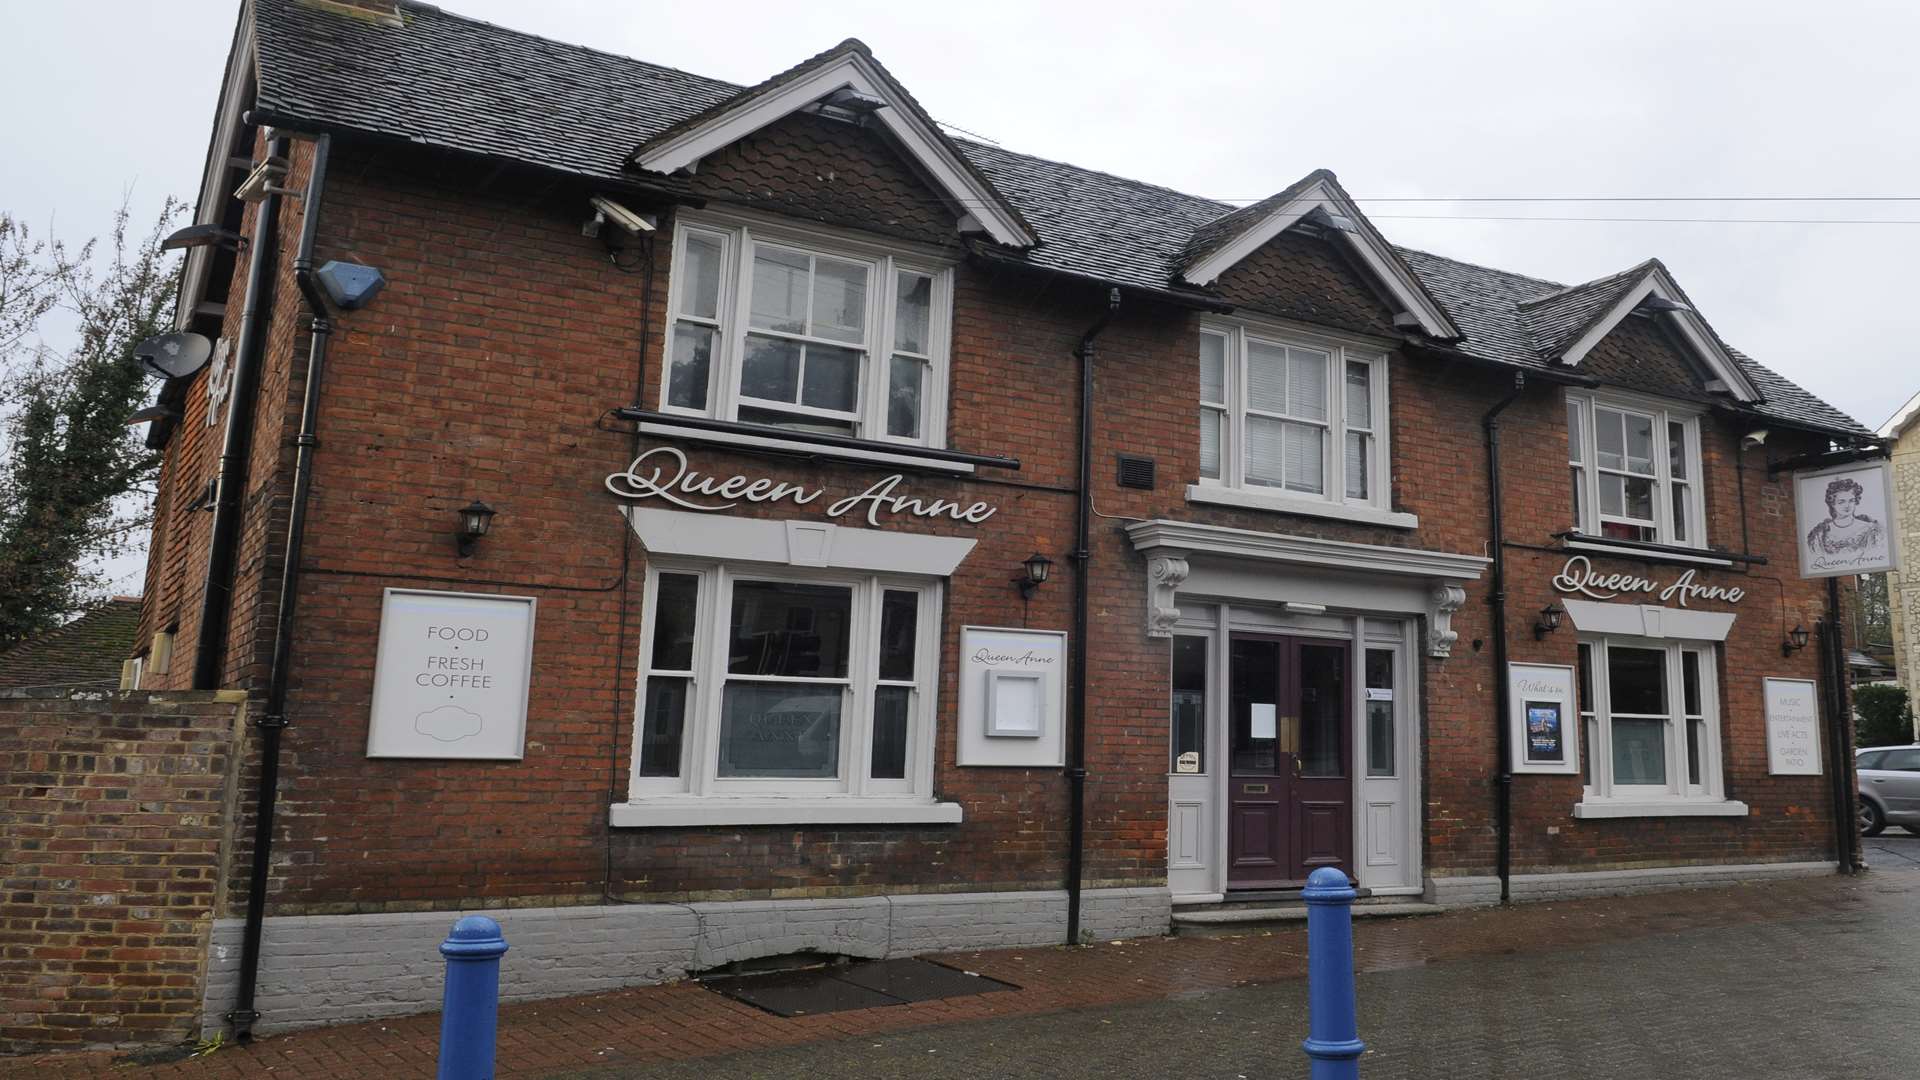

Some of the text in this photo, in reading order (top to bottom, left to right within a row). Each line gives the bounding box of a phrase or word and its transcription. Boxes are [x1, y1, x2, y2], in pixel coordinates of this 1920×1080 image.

[604, 446, 998, 527] Queen Anne
[1811, 555, 1850, 570] Queen
[1552, 555, 1746, 607] Queen Anne
[427, 626, 489, 642] FOOD
[427, 656, 485, 671] FRESH
[970, 647, 1057, 666] Queen Anne
[415, 673, 493, 689] COFFEE
